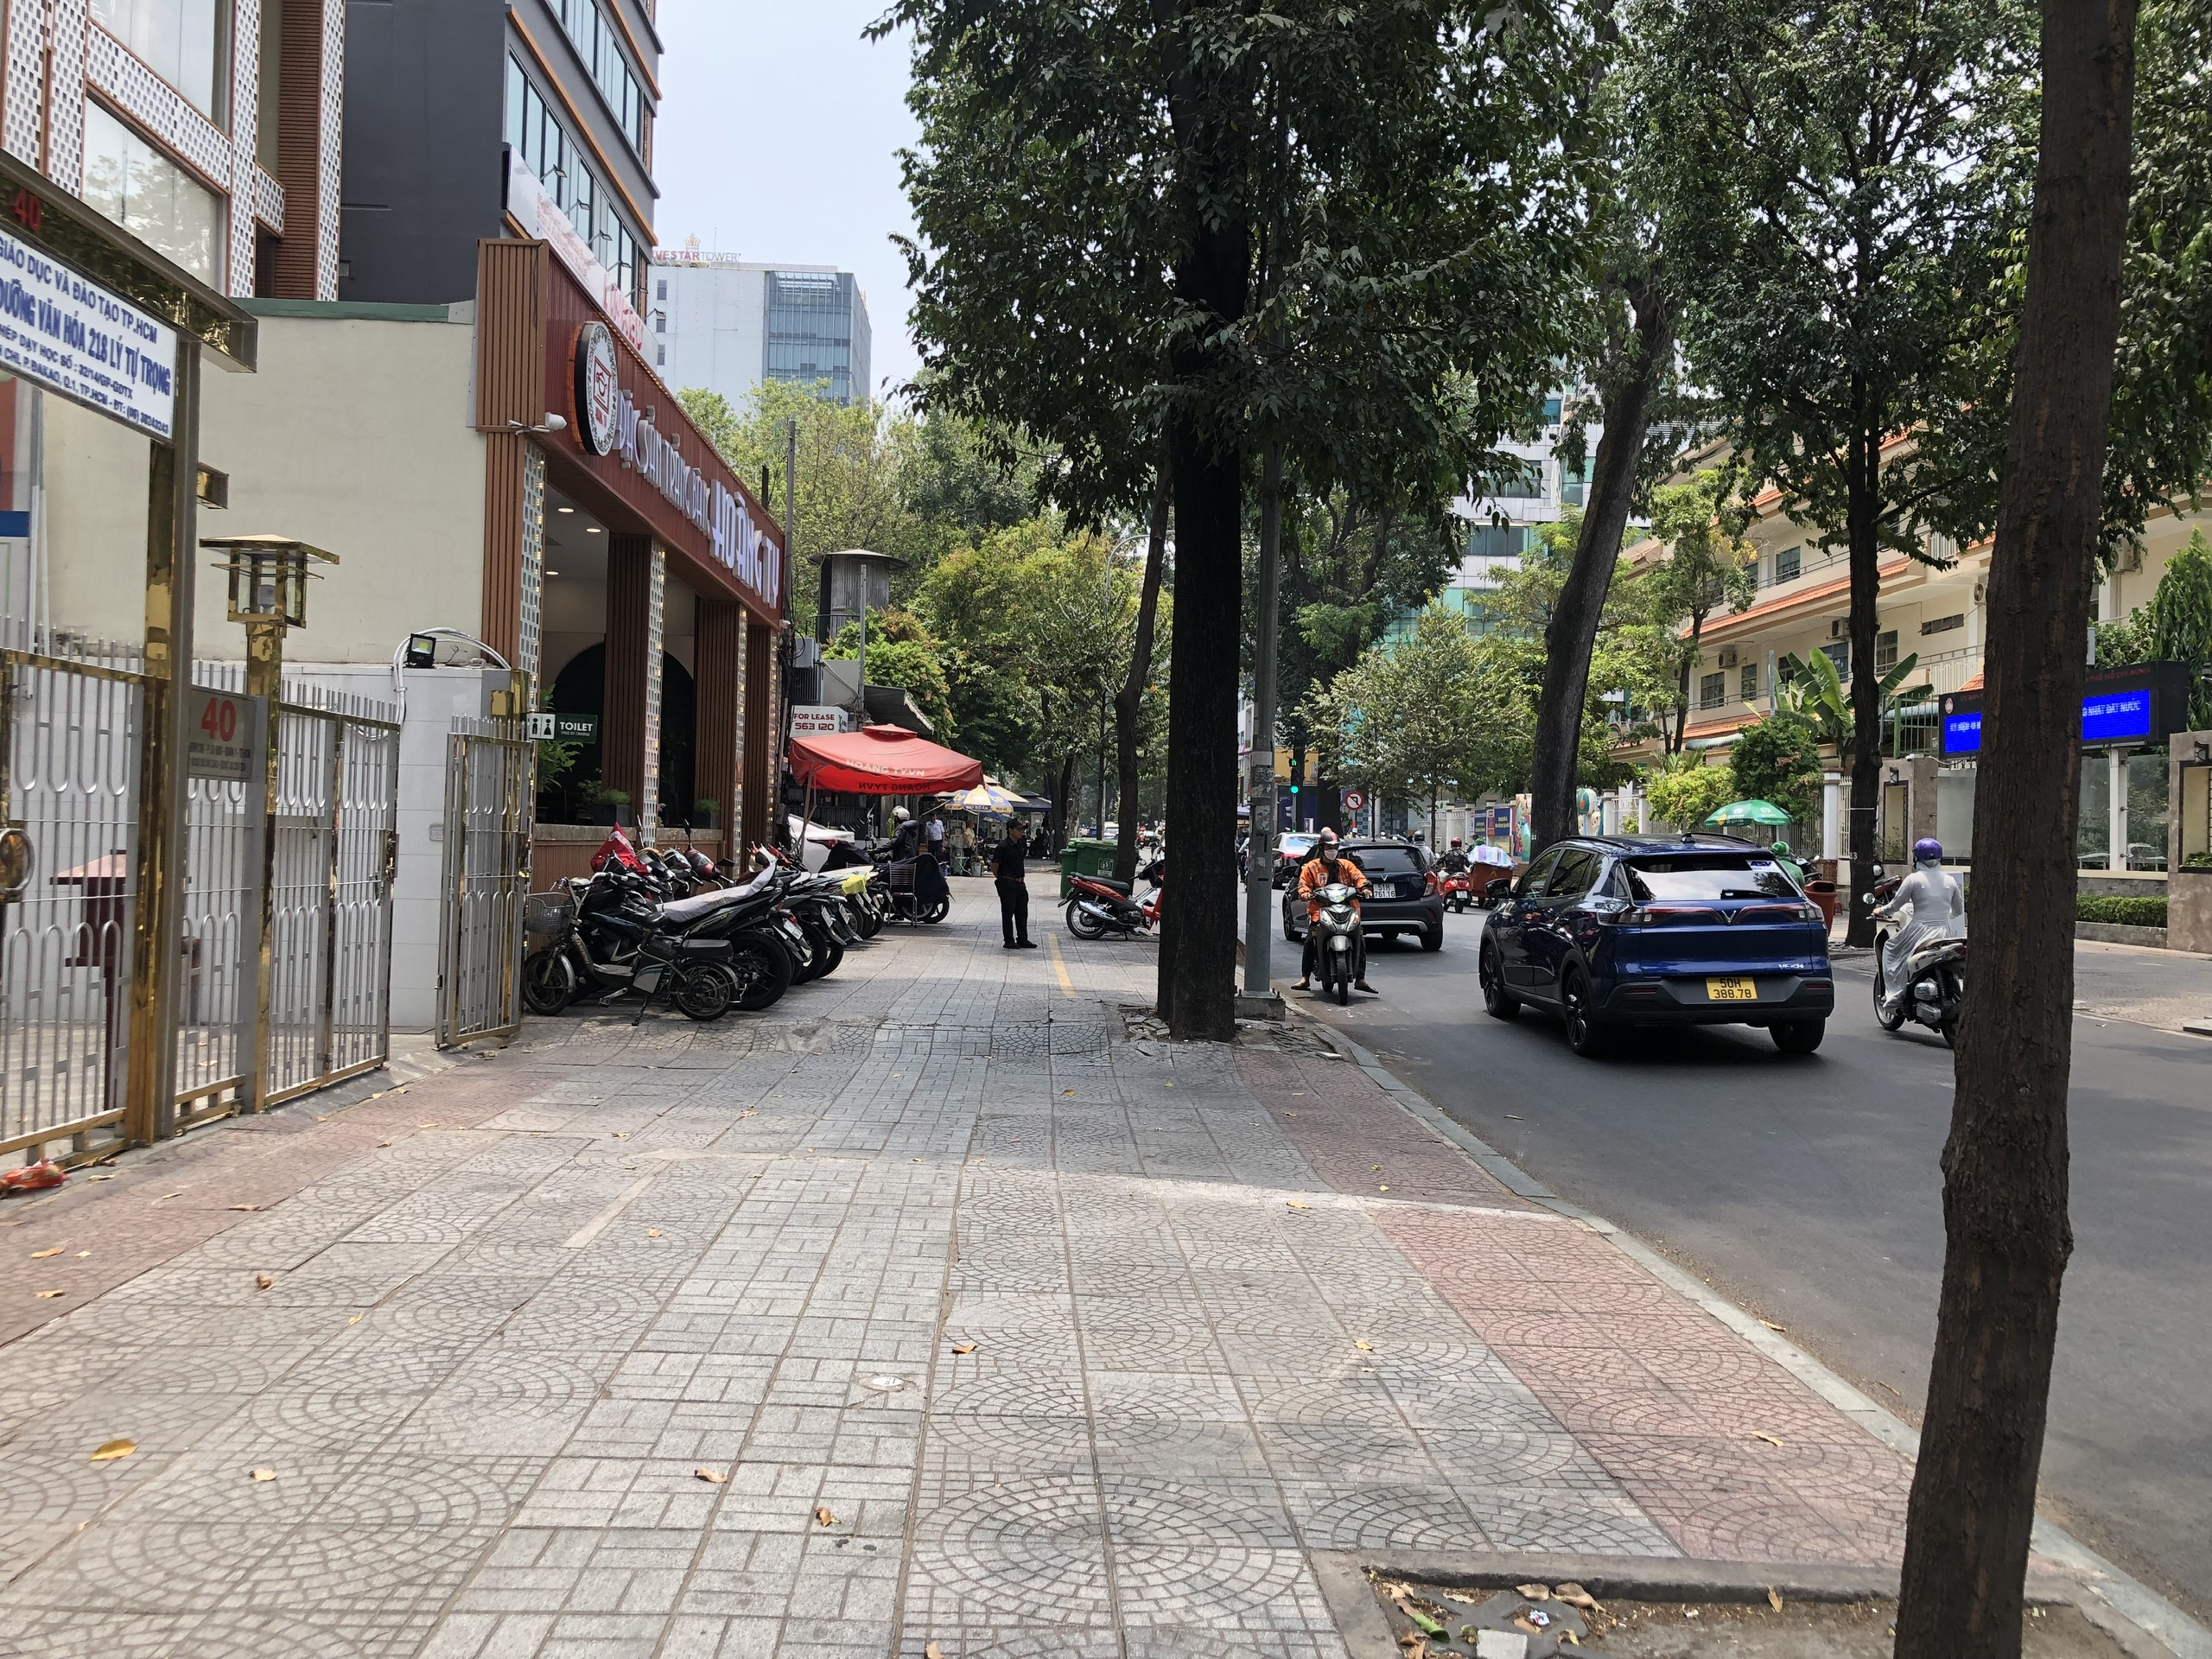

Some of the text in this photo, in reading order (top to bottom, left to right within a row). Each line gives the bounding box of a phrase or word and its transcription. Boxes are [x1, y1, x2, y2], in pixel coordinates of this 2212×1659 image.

[13, 188, 41, 232] 40
[701, 251, 738, 262] TOWER
[28, 254, 52, 284] DỤC
[54, 270, 70, 295] VÀ
[73, 281, 96, 308] ĐÀO
[98, 295, 119, 321] TẠO
[121, 308, 158, 344] TP.HCM
[38, 297, 61, 340] VĂN
[64, 310, 85, 353] HÓA
[88, 327, 107, 363] 218
[110, 335, 123, 370] LÝ
[125, 346, 139, 385] TỰ
[141, 354, 170, 397] TRỌNG
[710, 479, 780, 609] HOÀNG TY
[200, 696, 237, 742] 40
[559, 721, 593, 732] TOILET
[846, 760, 890, 774] HOANG
[1713, 988, 1752, 999] 388.78
[1719, 977, 1742, 988] 50H
